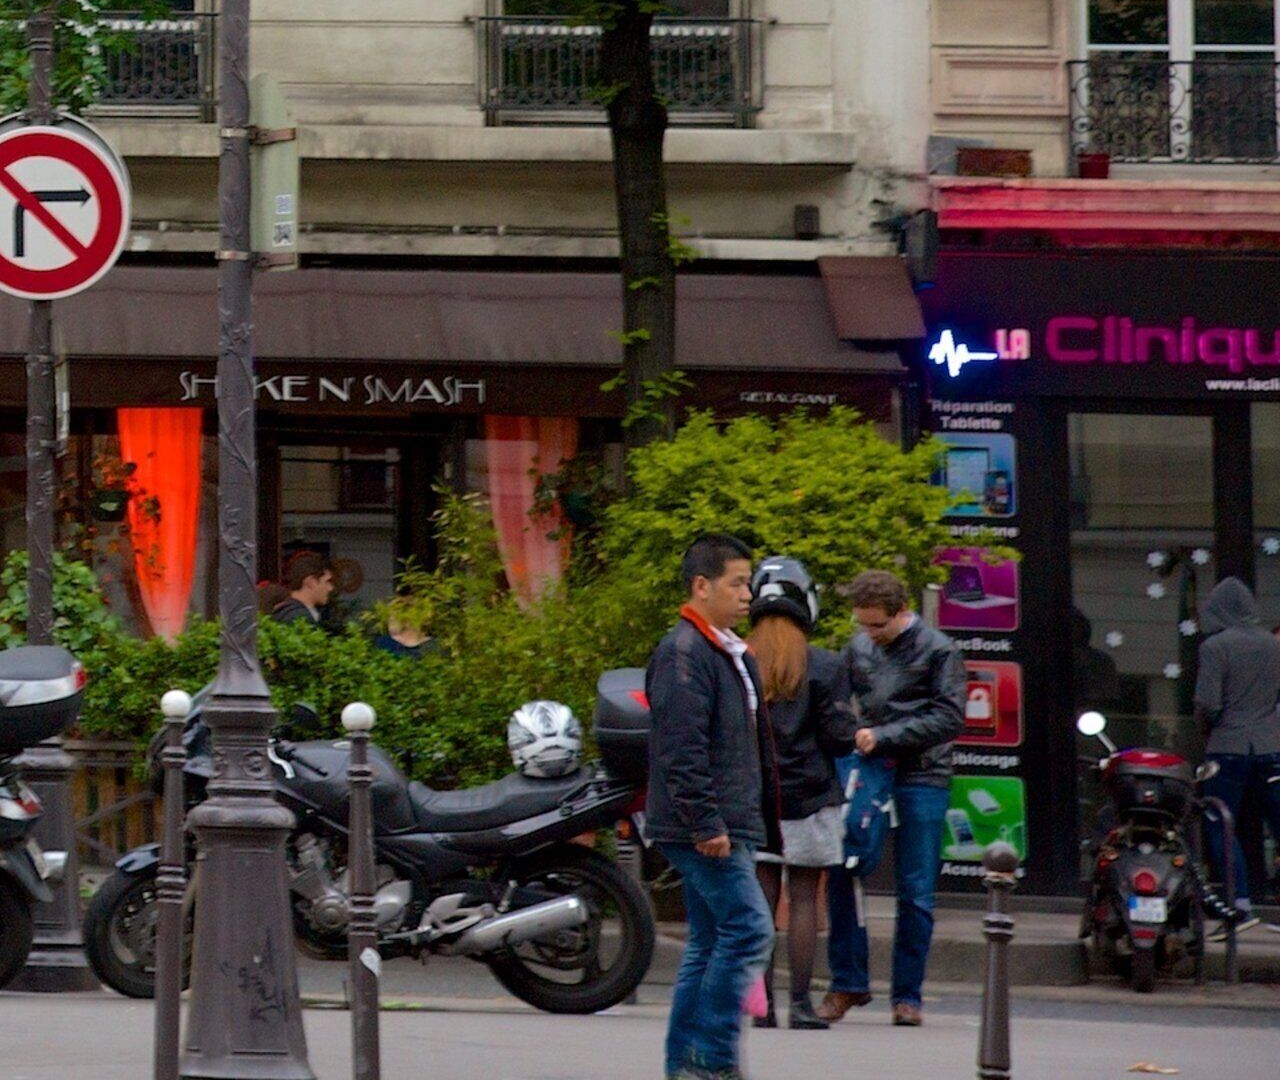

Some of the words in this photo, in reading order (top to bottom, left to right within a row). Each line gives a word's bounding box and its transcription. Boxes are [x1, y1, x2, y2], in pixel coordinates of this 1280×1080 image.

[995, 328, 1031, 360] LA
[179, 372, 308, 402] SHKE
[364, 375, 487, 406] SMASH
[931, 400, 1015, 415] Réparation
[940, 416, 1002, 430] Tablette
